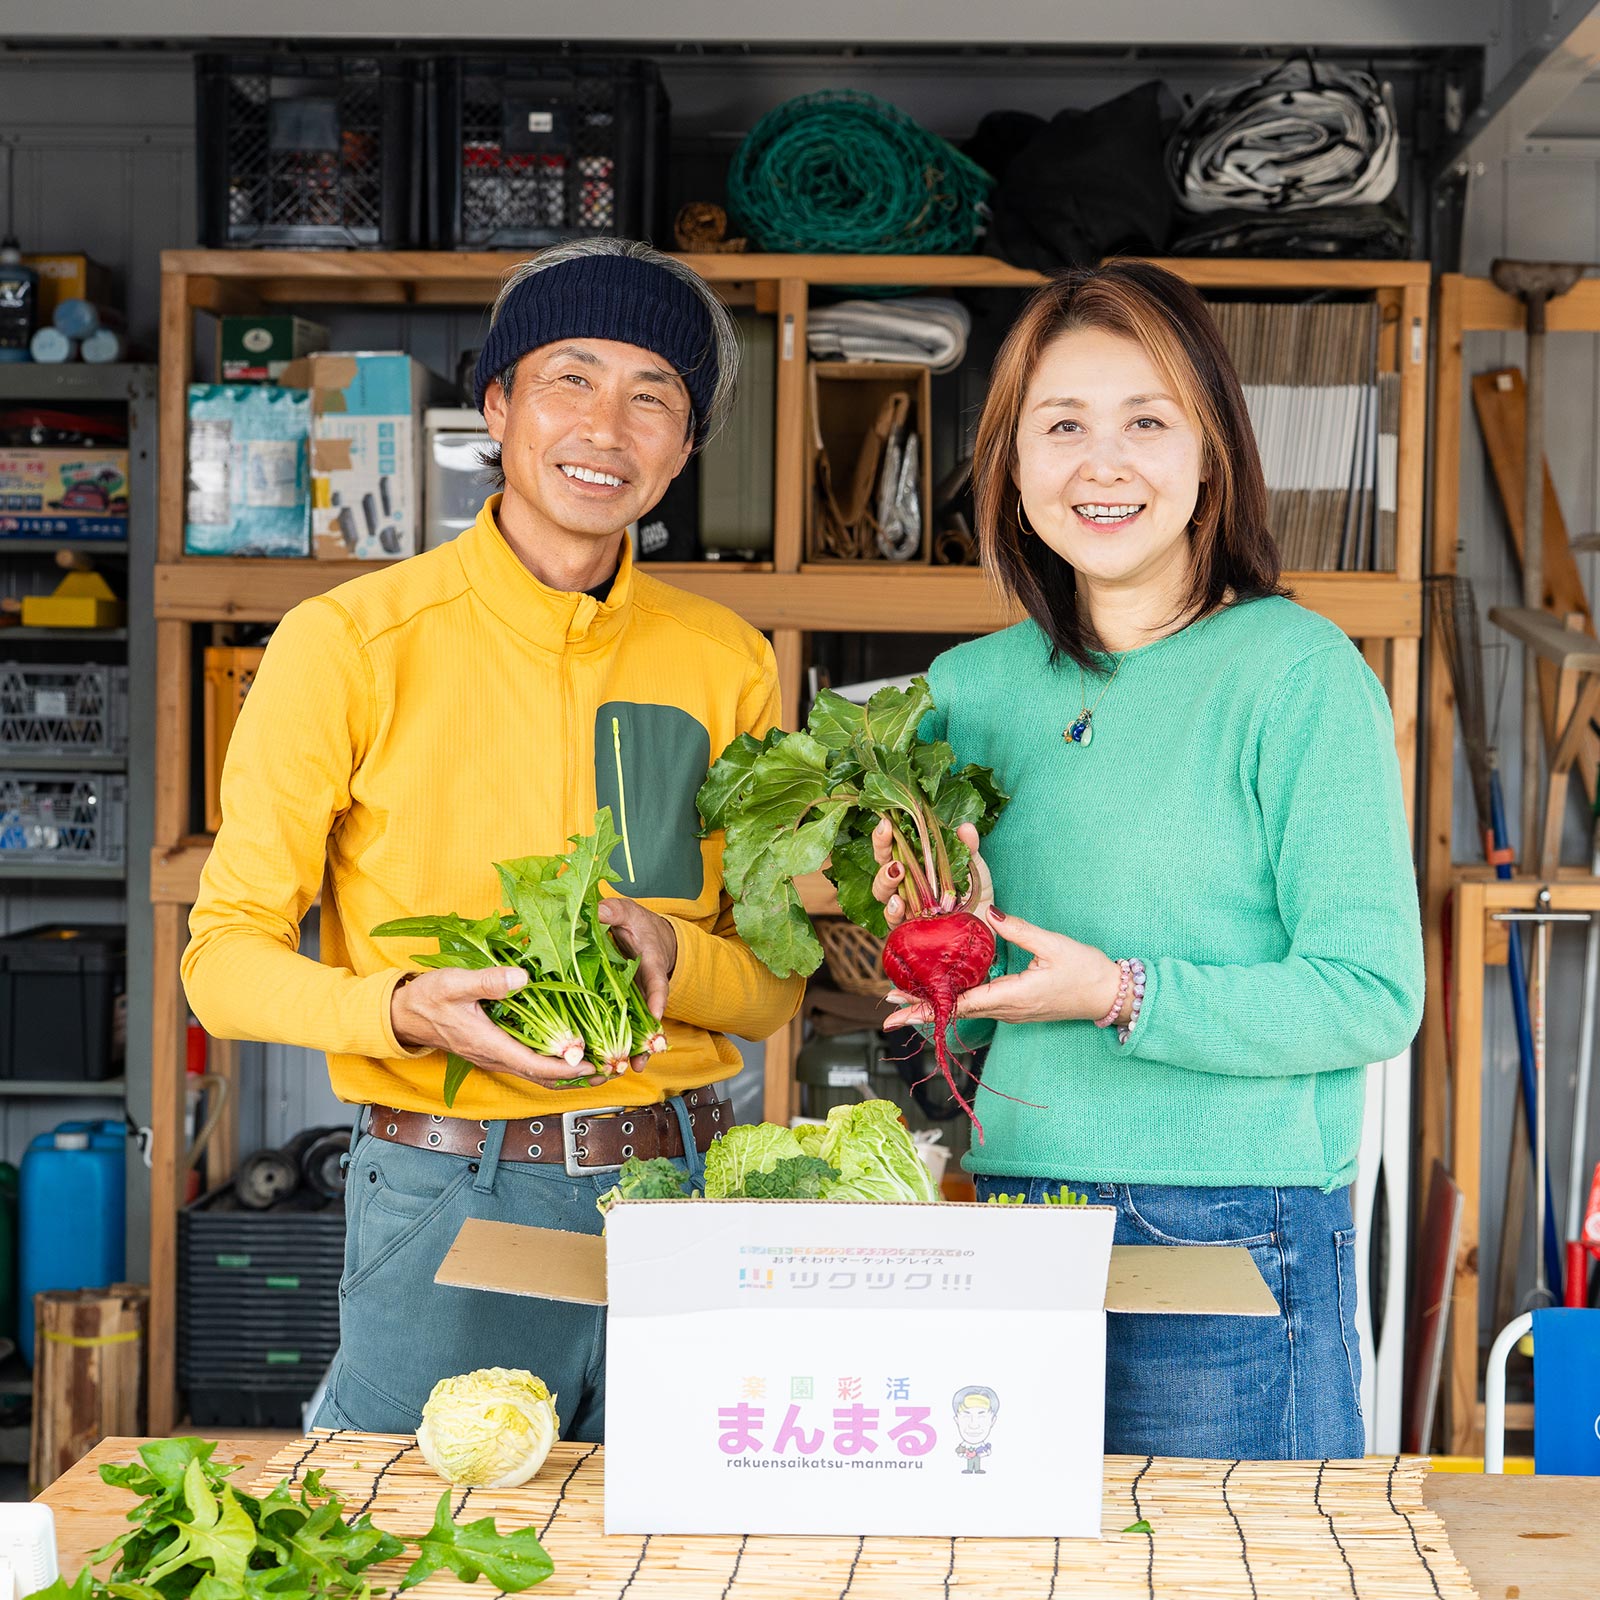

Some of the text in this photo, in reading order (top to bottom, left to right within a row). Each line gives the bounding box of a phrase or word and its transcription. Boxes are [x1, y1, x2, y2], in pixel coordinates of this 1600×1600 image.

[741, 1375, 911, 1400] 楽園彩活
[717, 1401, 938, 1457] まんまる
[726, 1456, 923, 1470] rakuensaikatsu-manmaru
